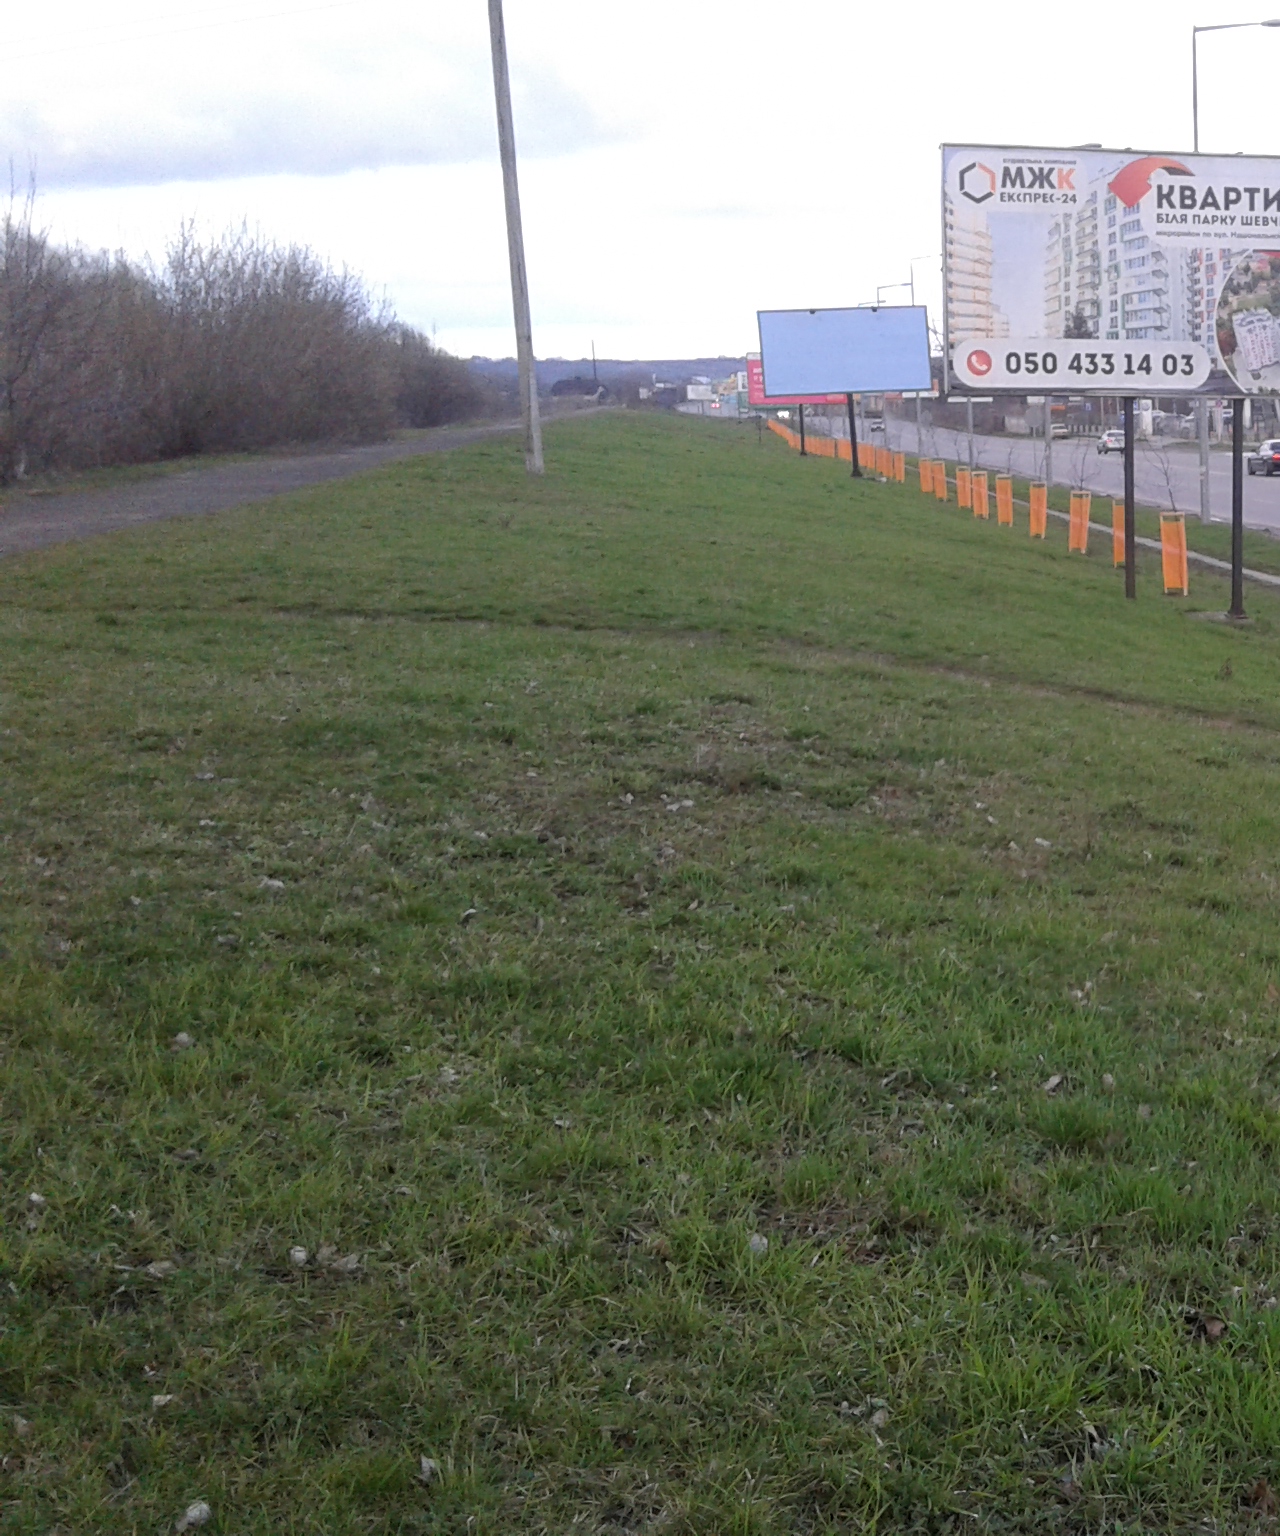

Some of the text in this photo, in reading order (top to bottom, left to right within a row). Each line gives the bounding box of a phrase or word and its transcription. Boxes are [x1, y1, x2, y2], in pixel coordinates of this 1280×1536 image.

[1001, 166, 1076, 190] МЖК
[1000, 192, 1077, 204] ЕКСПРЕС-24
[1156, 213, 1188, 225] БІЛЯ
[1192, 213, 1235, 226] ПАРКУ
[1005, 352, 1194, 376] 050 433 14 03
